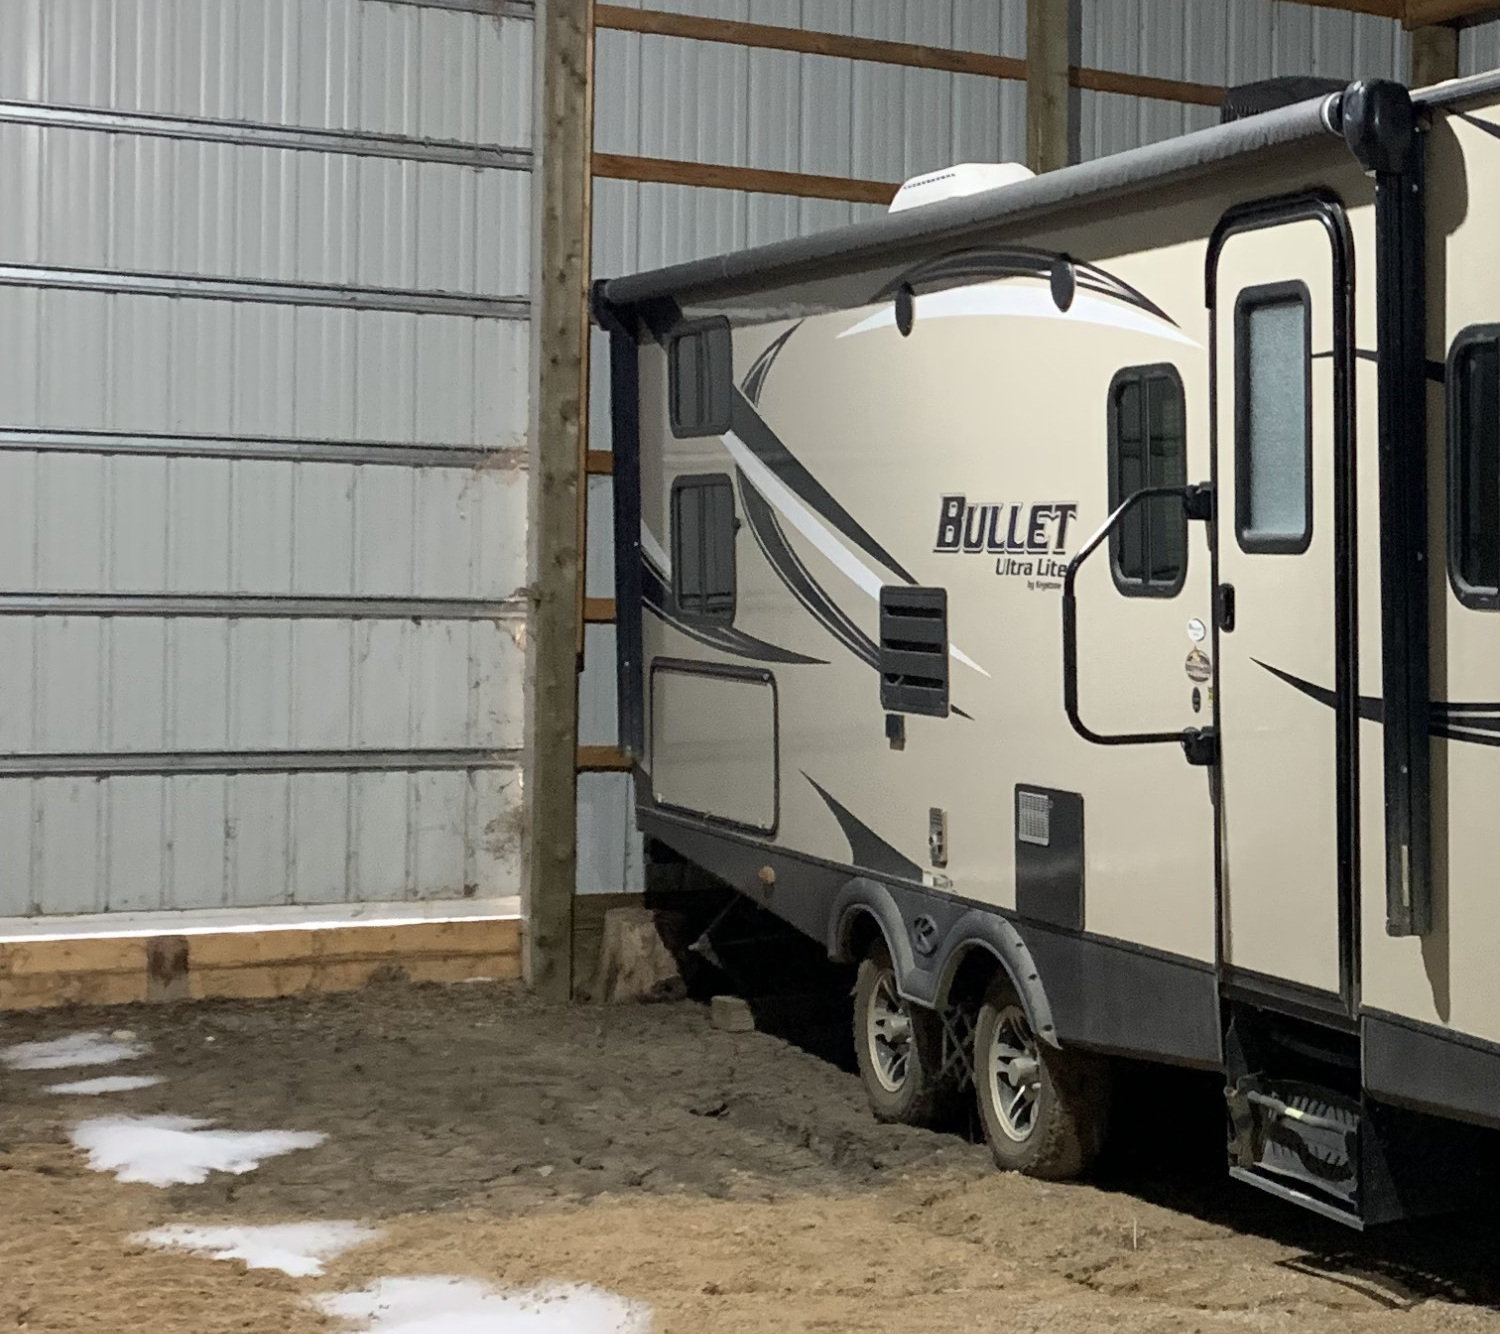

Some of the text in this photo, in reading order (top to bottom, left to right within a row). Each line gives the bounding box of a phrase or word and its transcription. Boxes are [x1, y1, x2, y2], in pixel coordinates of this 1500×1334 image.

[932, 493, 1079, 555] BULLET
[995, 558, 1068, 578] Ultra Lite
